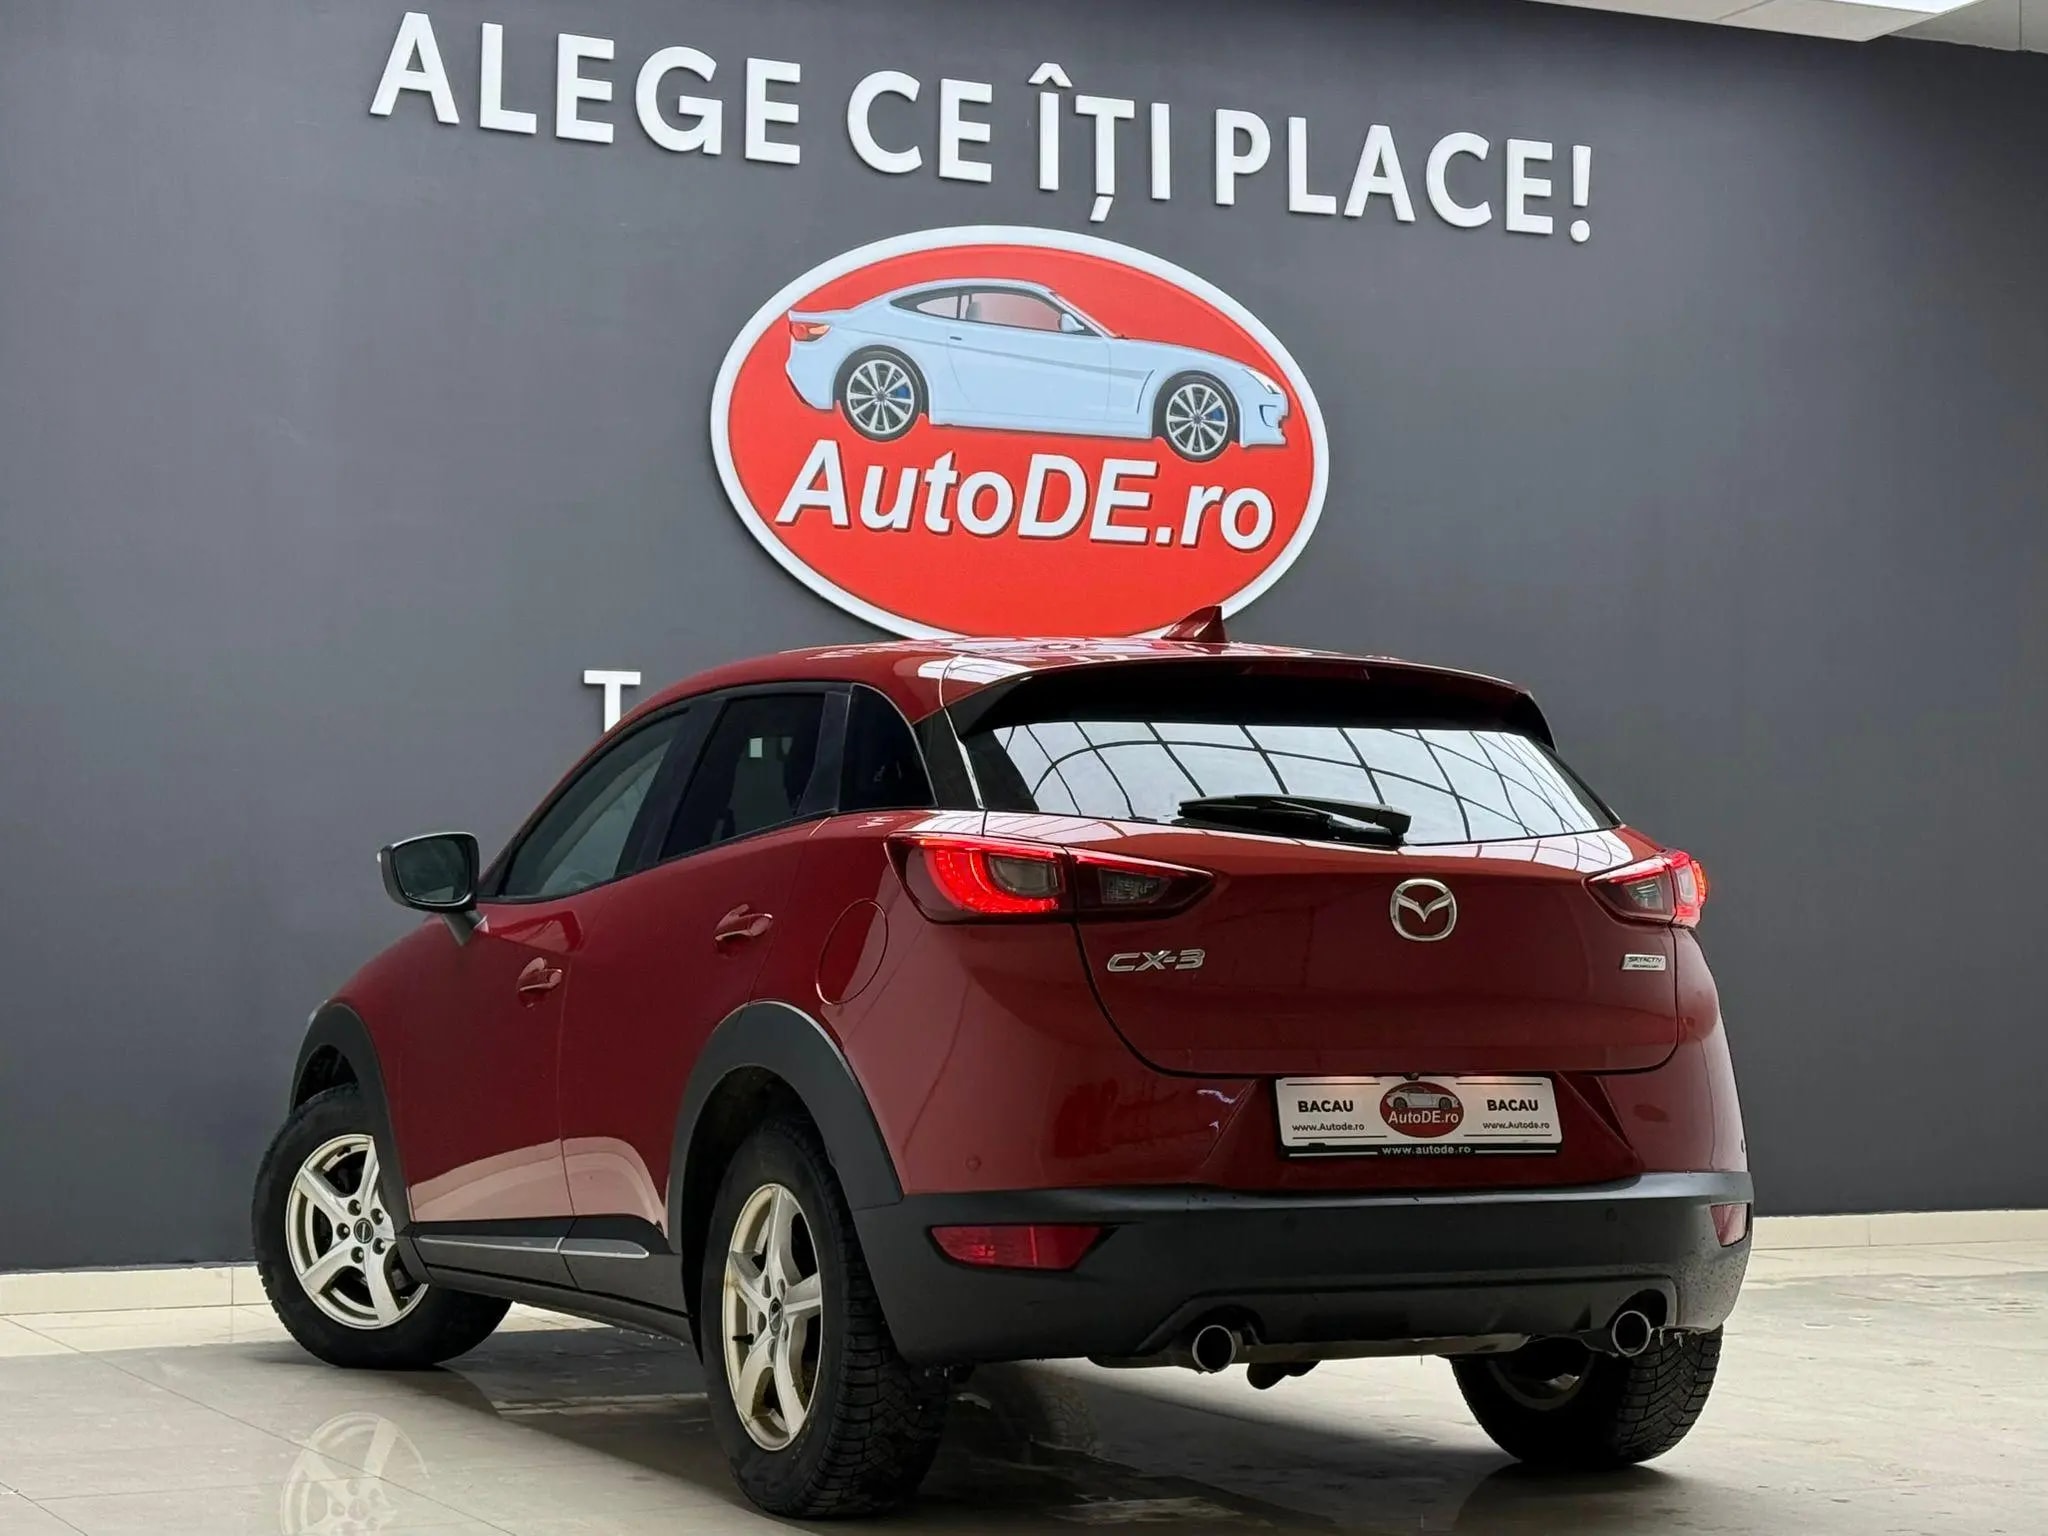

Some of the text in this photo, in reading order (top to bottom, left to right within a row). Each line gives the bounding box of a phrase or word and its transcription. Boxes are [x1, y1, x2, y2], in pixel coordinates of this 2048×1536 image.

[370, 12, 1592, 242] ALEGE CE ÎȚI PLACE!
[774, 439, 1274, 552] AutoDE.ro
[1107, 949, 1205, 972] CX-3
[1297, 1100, 1354, 1113] BACAU
[1487, 1099, 1539, 1112] BACAU
[1387, 1109, 1460, 1125] AutoDE.ro
[1291, 1122, 1365, 1132] www.Autode.ro
[1482, 1121, 1551, 1130] www.Autode.ro
[1381, 1144, 1472, 1155] www.autode.ro
